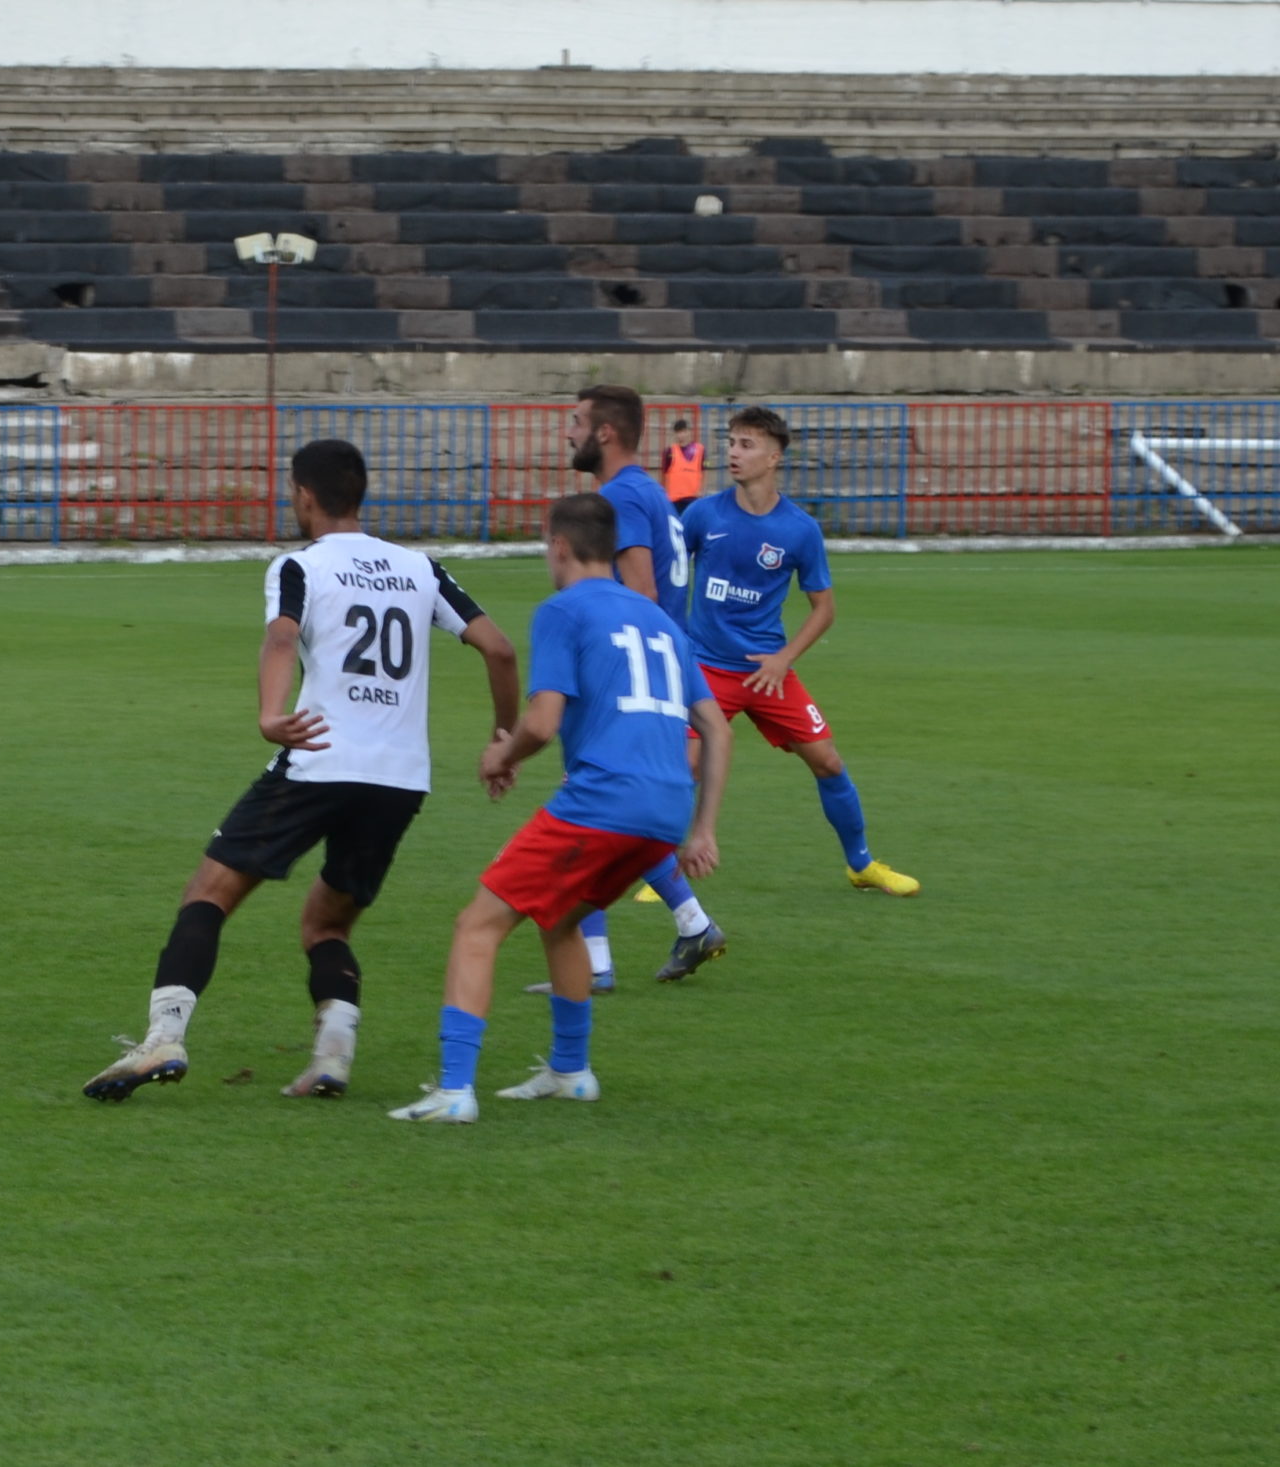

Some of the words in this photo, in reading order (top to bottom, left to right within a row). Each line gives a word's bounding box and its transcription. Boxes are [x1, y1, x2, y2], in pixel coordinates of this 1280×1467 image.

[668, 515, 689, 588] 5
[352, 557, 392, 575] CSM
[334, 572, 418, 593] VICTORIA
[728, 585, 763, 603] MARTY
[341, 604, 414, 681] 20
[610, 623, 690, 722] 11
[348, 685, 400, 706] CAREI
[806, 703, 823, 724] 8
